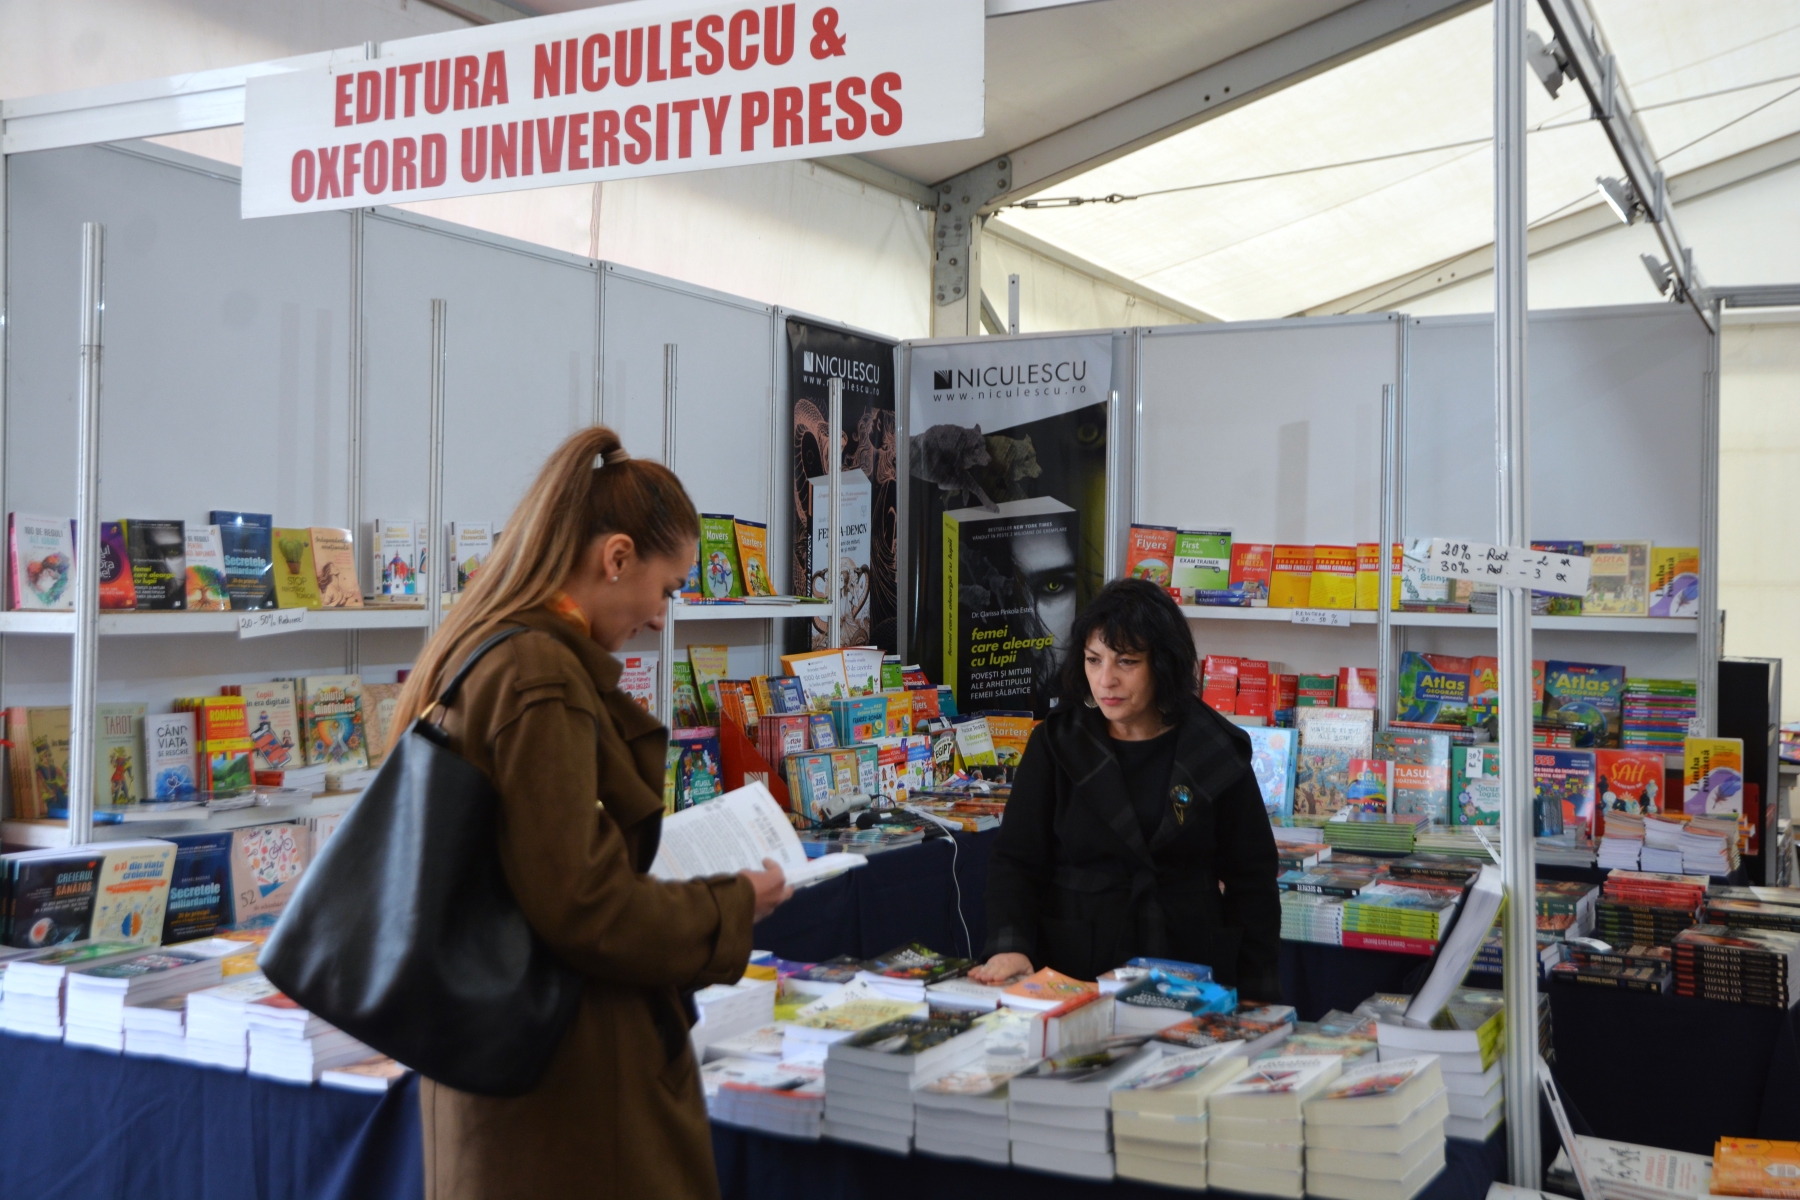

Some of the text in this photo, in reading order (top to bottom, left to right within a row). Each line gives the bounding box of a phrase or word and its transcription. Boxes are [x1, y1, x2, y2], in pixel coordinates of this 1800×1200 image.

[334, 3, 847, 128] EDITURA NICULESCU &
[291, 71, 902, 203] OXFORD UNIVERSITY PRESS
[816, 354, 880, 384] NICULESCU
[958, 360, 1086, 388] NICULESCU
[803, 375, 879, 396] www.nulescu.ro
[933, 384, 1086, 402] www.niculescu.ro
[706, 530, 729, 540] Movers
[1136, 539, 1167, 551] Flyers
[1181, 541, 1200, 549] First
[1441, 542, 1471, 560] 20%
[224, 554, 266, 567] Secretele
[1595, 555, 1625, 564] ARTA
[1440, 560, 1469, 574] 30%
[1533, 568, 1541, 579] 3
[287, 576, 308, 586] STOP
[1655, 564, 1666, 597] Limba
[1666, 557, 1675, 598] română
[980, 610, 999, 618] Clarissa
[1000, 608, 1019, 616] Pinkola
[972, 625, 1008, 640] femei
[971, 633, 1055, 653] care aleargă
[971, 650, 1017, 667] cu lupii
[1008, 667, 1032, 676] MITURI
[971, 677, 1031, 690] ALE ARHETIPULUI
[1306, 677, 1331, 689] PONS
[1420, 674, 1466, 691] Atlas
[1555, 673, 1611, 692] Atlas
[971, 687, 1031, 700] FEMEII SĂLBATICE
[1425, 688, 1465, 696] GEOGRAFIC
[1561, 688, 1606, 697] GEOGRAFIC
[209, 706, 245, 722] ROMÂNIA
[314, 702, 356, 715] mindfulness
[103, 715, 133, 735] TAROT
[989, 727, 1028, 737] Starters
[165, 748, 189, 756] RESCRIE
[935, 742, 952, 759] EGIPT
[1534, 754, 1556, 766] 555
[1356, 771, 1383, 782] GRIT
[1394, 767, 1432, 779] TLASUL
[1690, 757, 1700, 792] Limba
[1701, 749, 1710, 793] română
[129, 861, 142, 871] din
[57, 870, 94, 884] CREIERUL
[123, 868, 163, 880] creierului
[170, 882, 221, 900] Secretele
[1296, 884, 1316, 893] SECRETE
[169, 895, 221, 910] miliardarilor
[241, 889, 257, 908] 52
